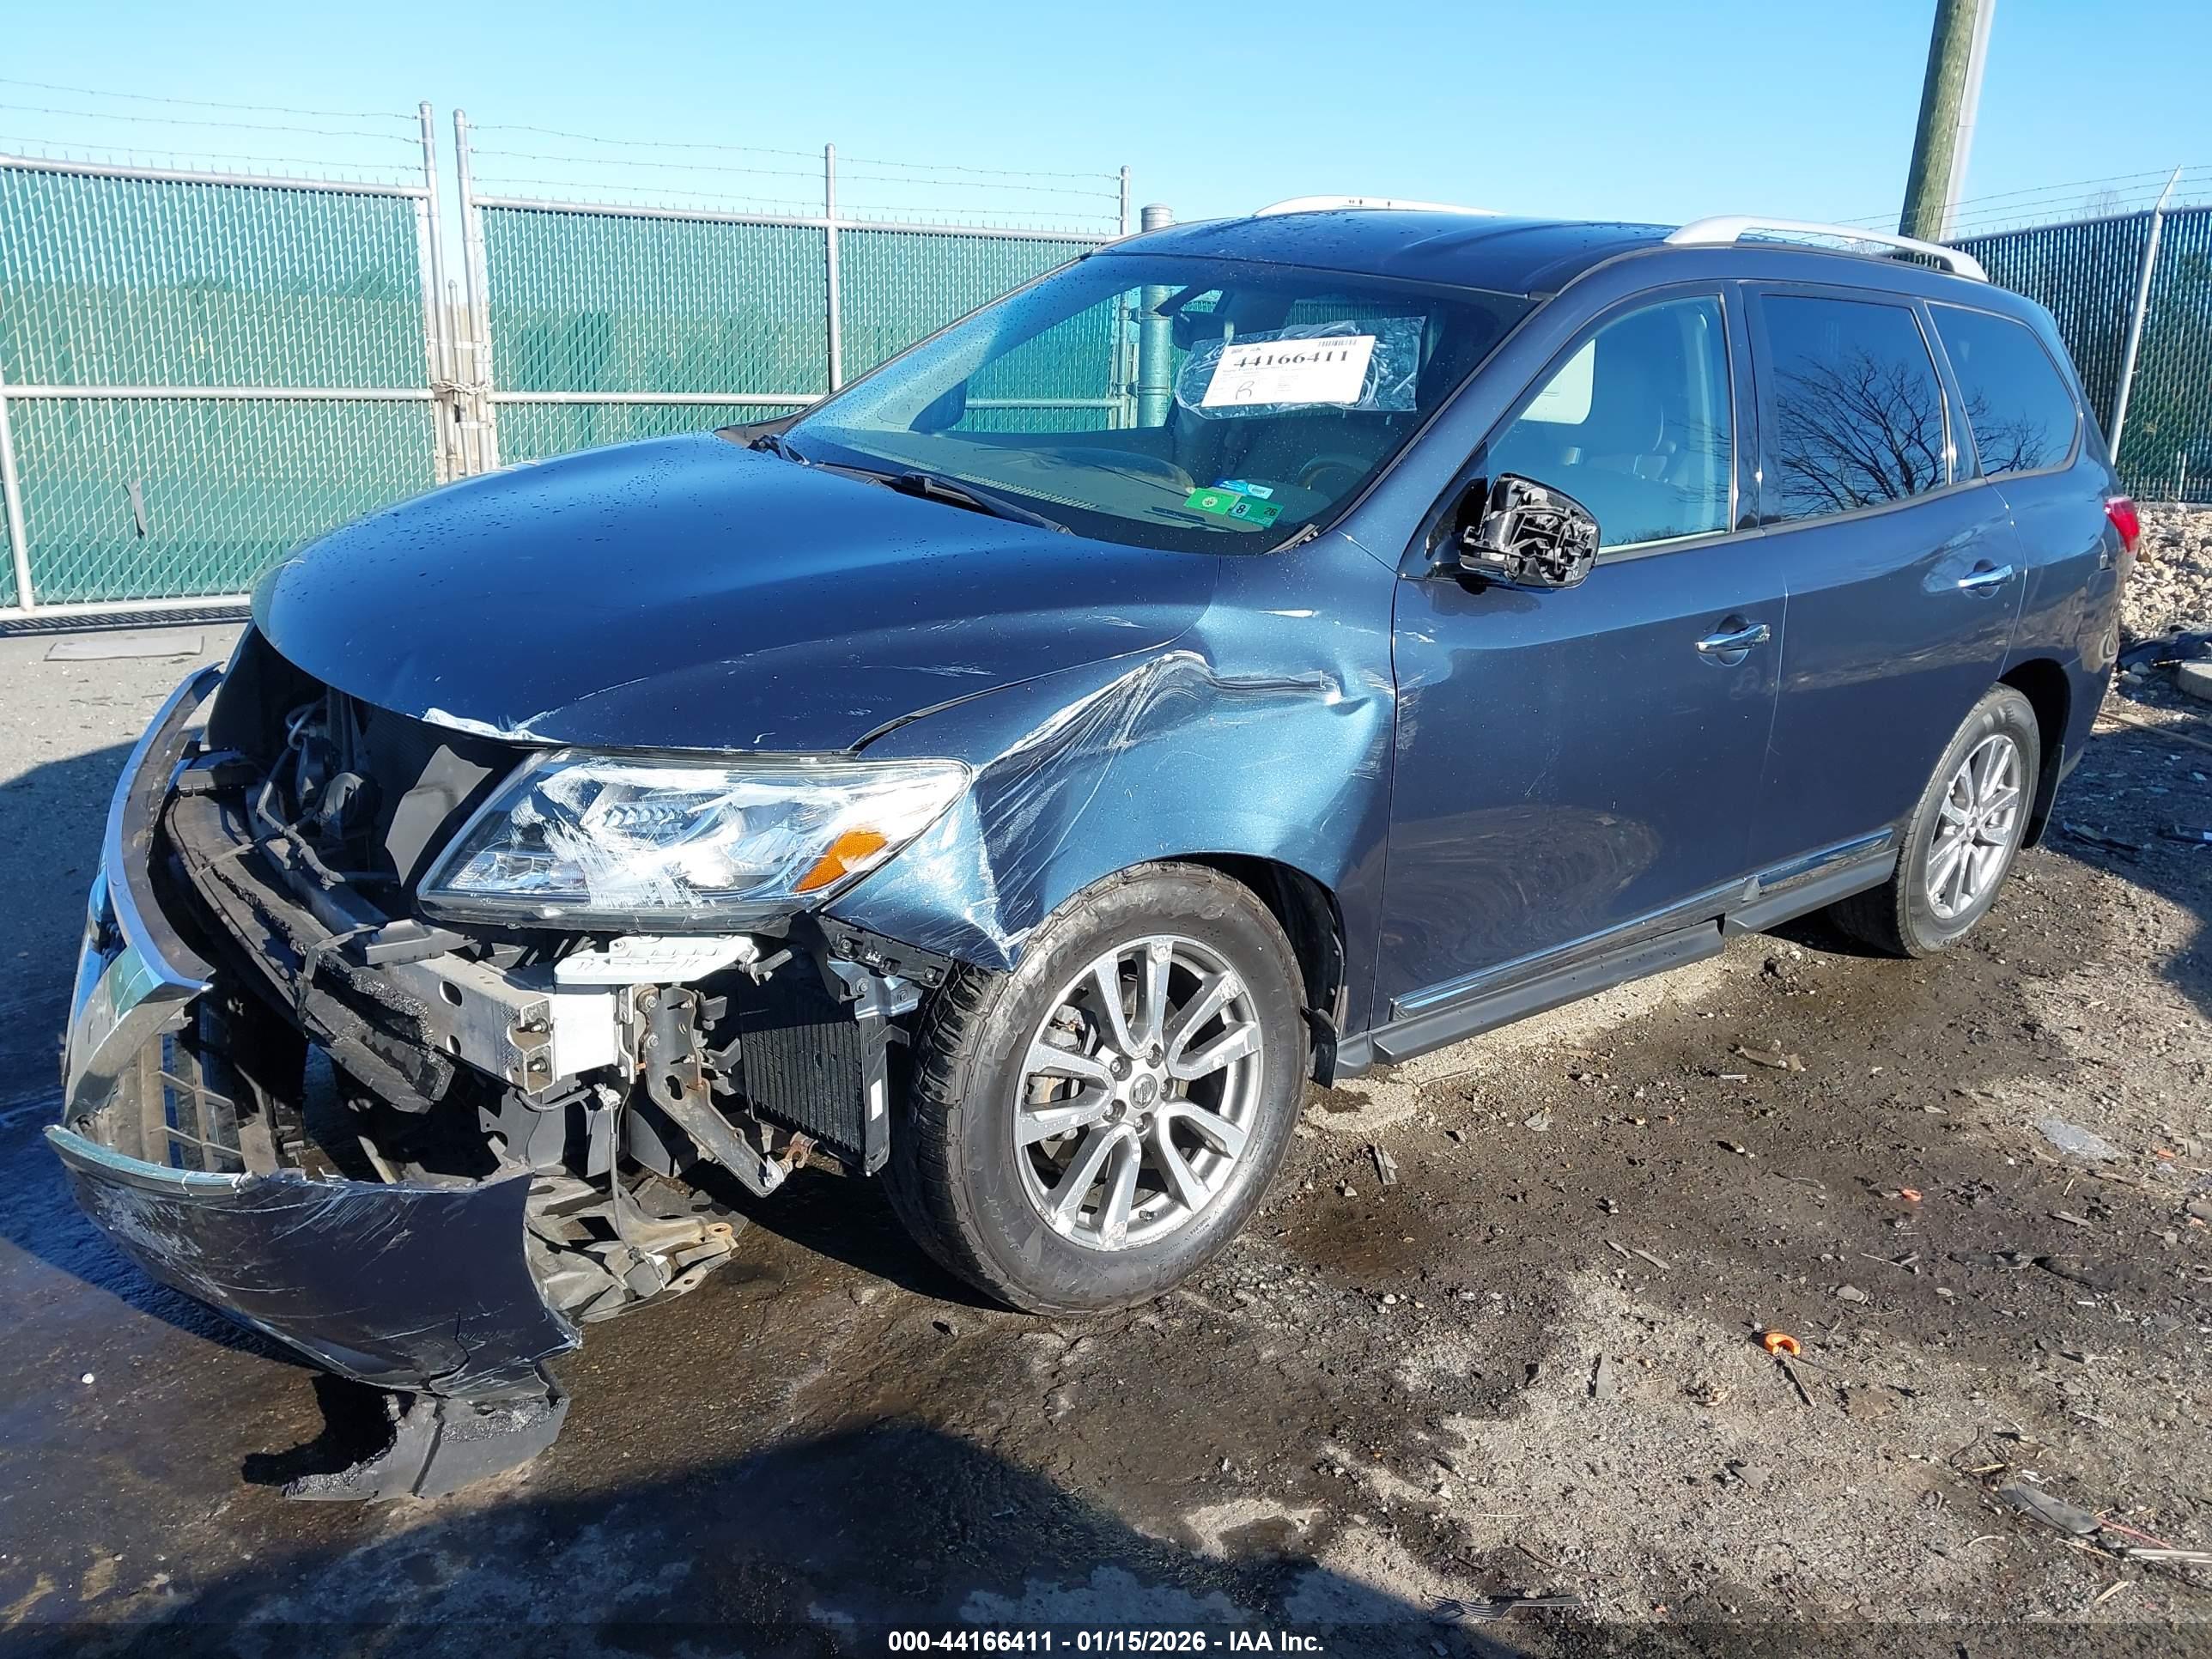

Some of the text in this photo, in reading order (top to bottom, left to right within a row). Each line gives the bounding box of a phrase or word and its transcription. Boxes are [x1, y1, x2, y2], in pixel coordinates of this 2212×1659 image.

[1234, 350, 1348, 368] 44166411
[1237, 504, 1279, 517] 8 26
